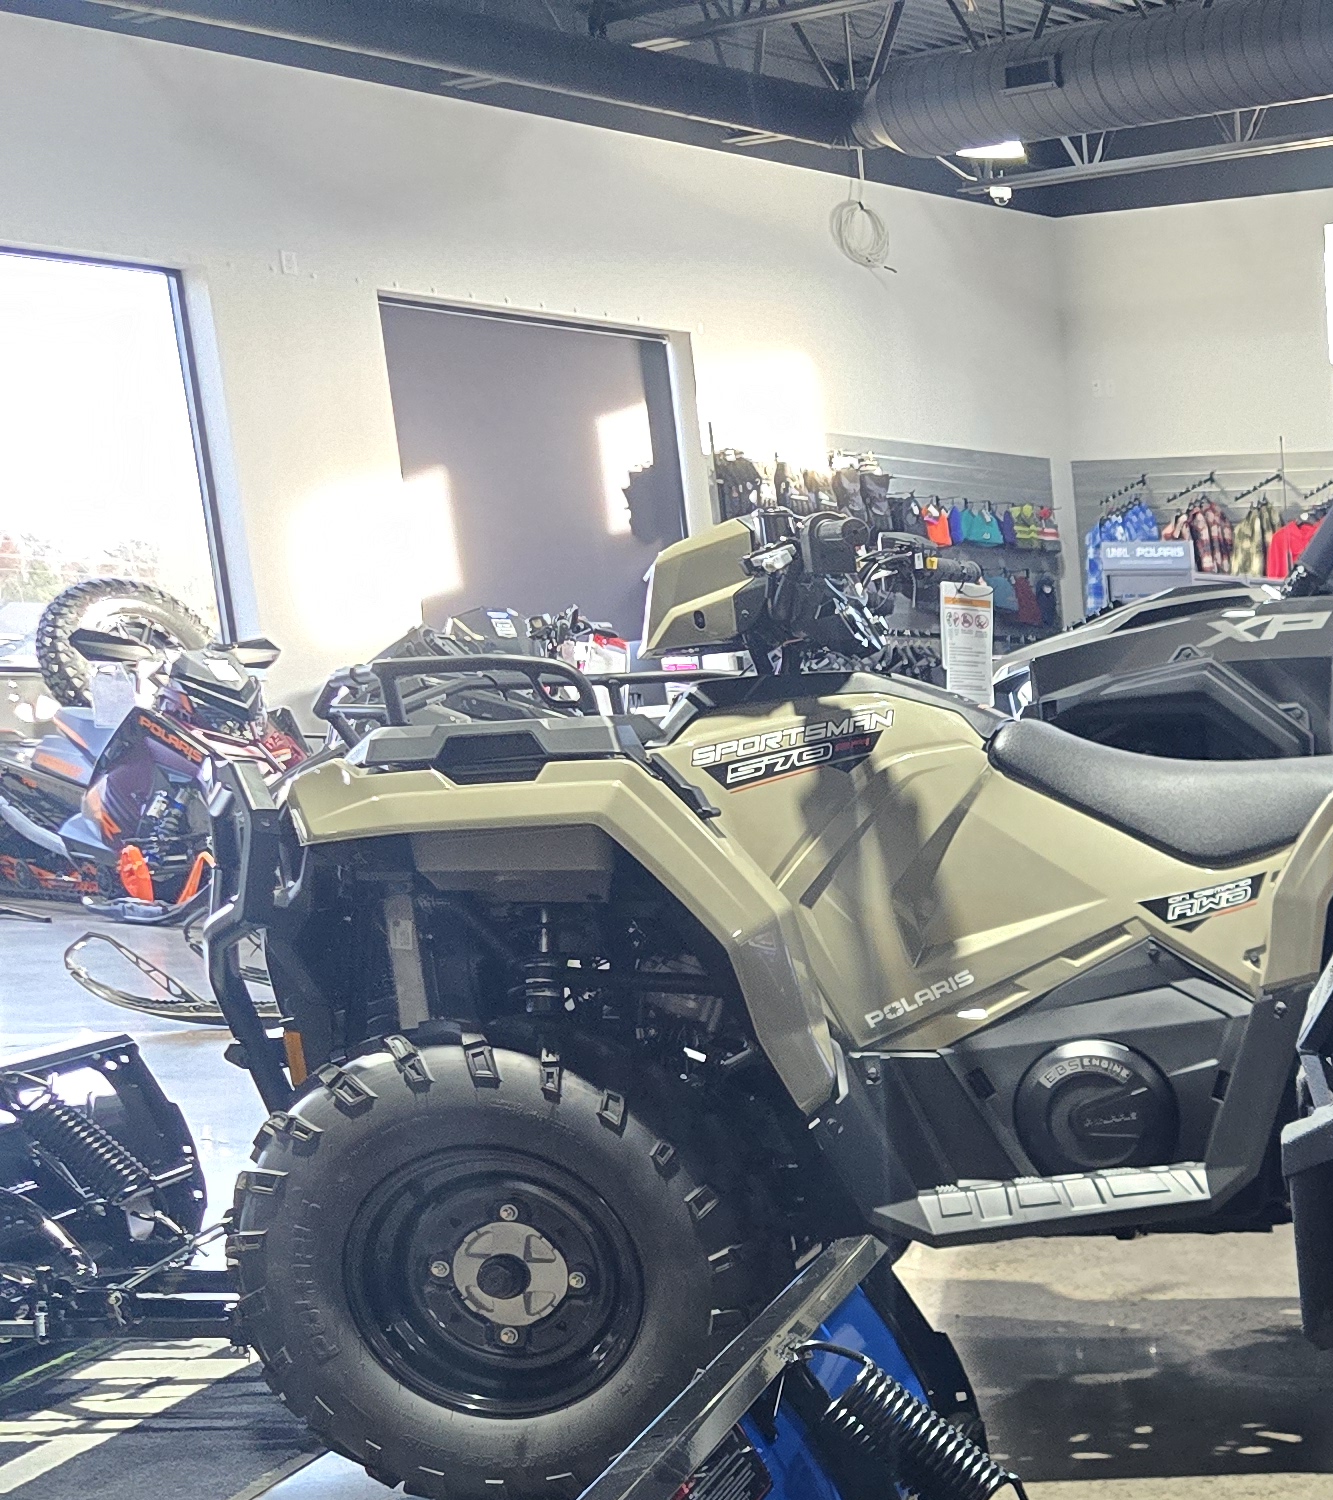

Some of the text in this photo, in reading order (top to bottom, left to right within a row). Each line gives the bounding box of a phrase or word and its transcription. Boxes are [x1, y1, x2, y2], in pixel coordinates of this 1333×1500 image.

[1136, 546, 1185, 558] POLARIS
[1196, 610, 1333, 648] XP
[137, 715, 204, 763] POLARIS
[691, 709, 895, 767] SPORTSMAN
[726, 742, 833, 784] 570
[1167, 886, 1252, 921] AWD
[864, 969, 975, 1029] POLARIS
[1044, 1060, 1079, 1084] EBS
[1082, 1057, 1131, 1079] ENGINE
